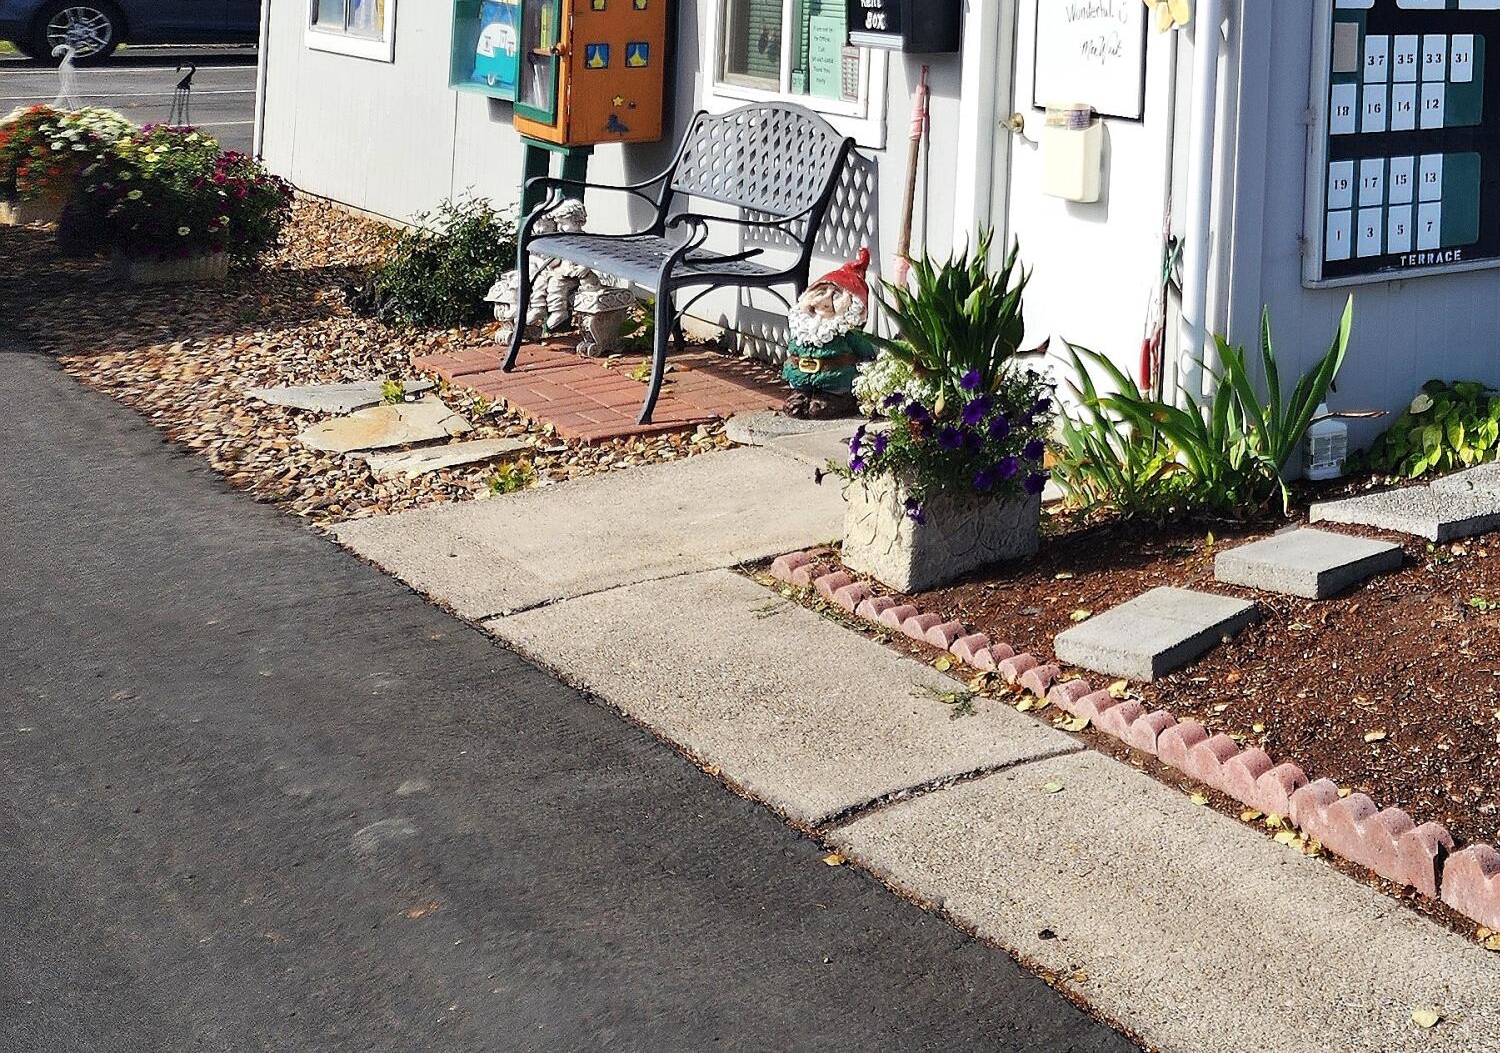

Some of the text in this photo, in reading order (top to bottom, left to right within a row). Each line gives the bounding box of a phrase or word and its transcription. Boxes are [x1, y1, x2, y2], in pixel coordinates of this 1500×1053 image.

[1367, 54, 1385, 66] 37
[1397, 53, 1414, 65] 35
[1425, 53, 1442, 64] 33
[1455, 52, 1468, 63] 31
[1368, 103, 1381, 115] 16
[1398, 101, 1411, 112] 14
[1426, 98, 1439, 110] 12
[1337, 105, 1350, 117] 18
[1364, 176, 1378, 188] 17
[1395, 174, 1407, 186] 15
[1425, 172, 1437, 183] 13
[1334, 179, 1348, 190] 19
[1366, 226, 1374, 238] 3
[1397, 224, 1404, 235] 5
[1426, 221, 1433, 232] 7
[1337, 230, 1341, 241] 1
[1400, 249, 1462, 267] TERRACE
